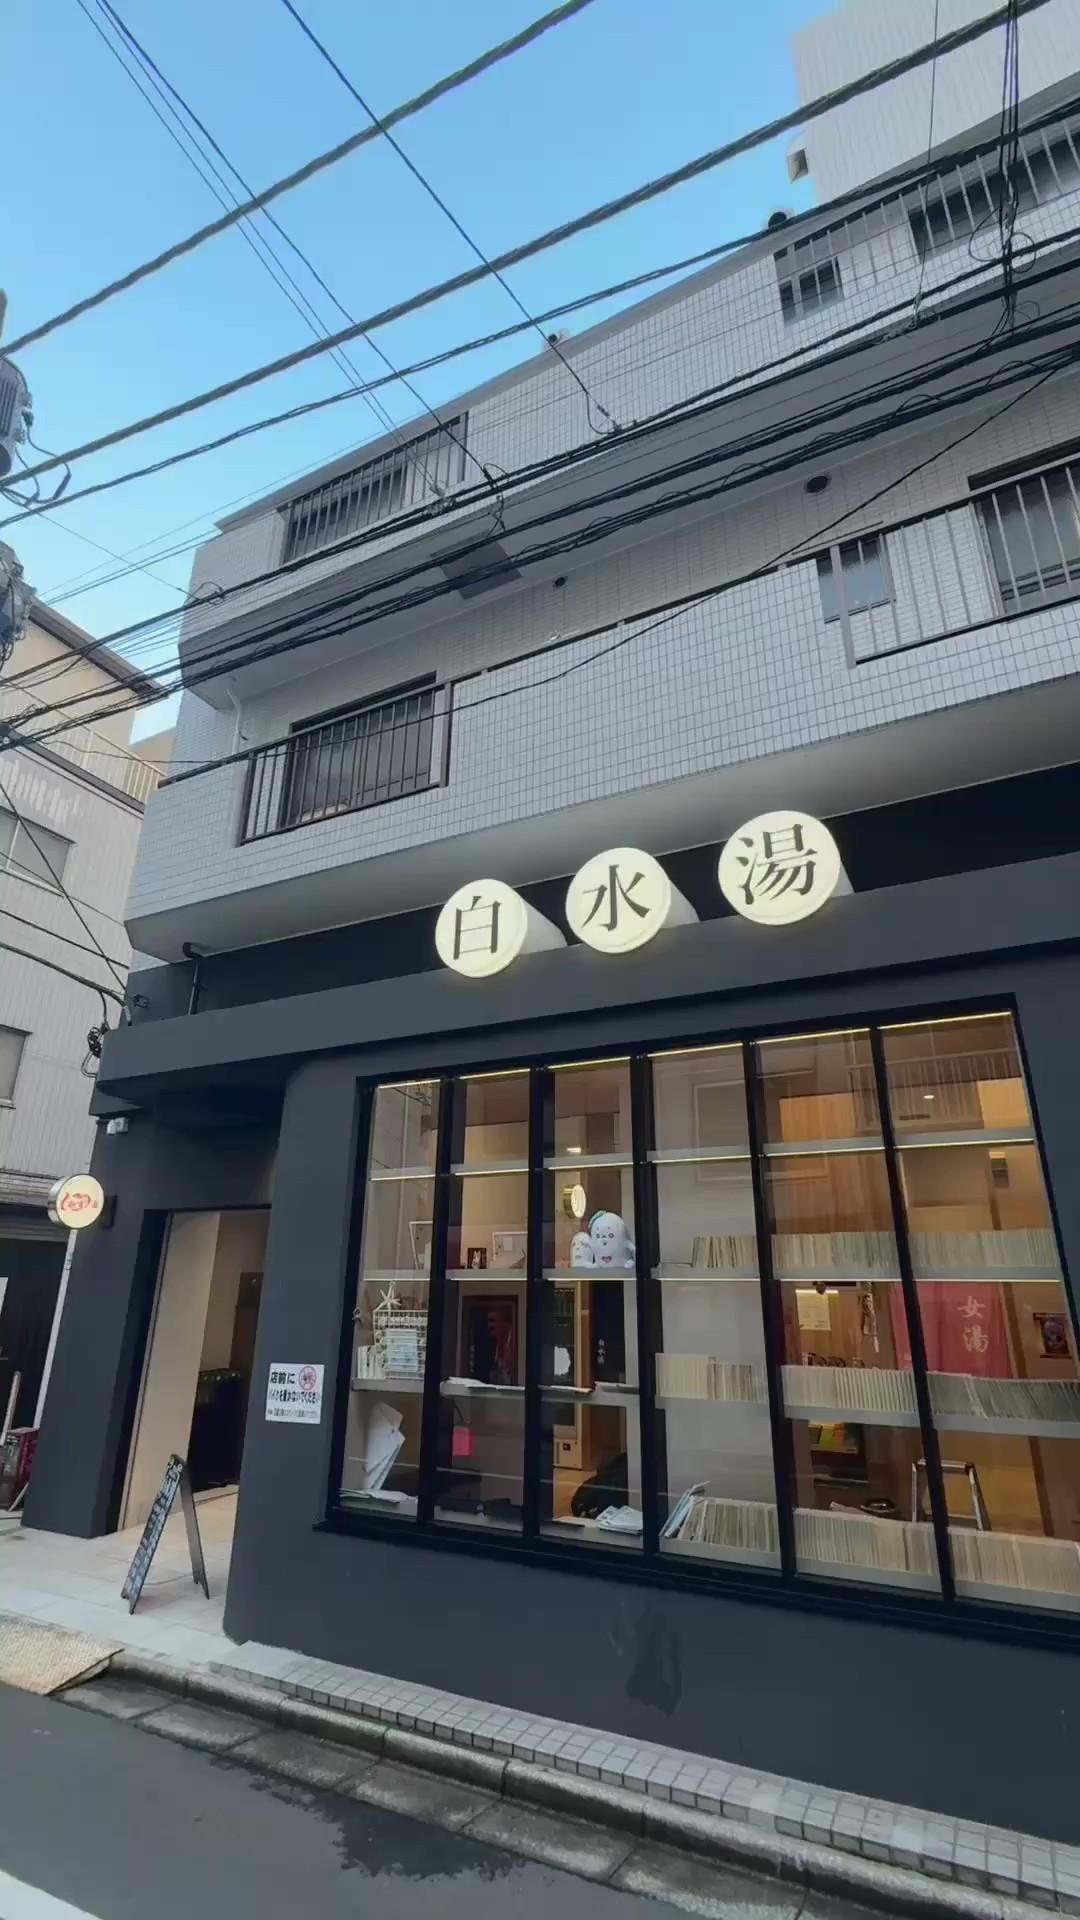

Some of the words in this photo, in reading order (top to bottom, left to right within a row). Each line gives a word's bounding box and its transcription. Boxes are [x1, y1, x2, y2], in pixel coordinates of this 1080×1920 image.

[452, 823, 818, 960] 白水湯
[957, 1295, 990, 1353] 女湯
[270, 1371, 296, 1385] 店前に
